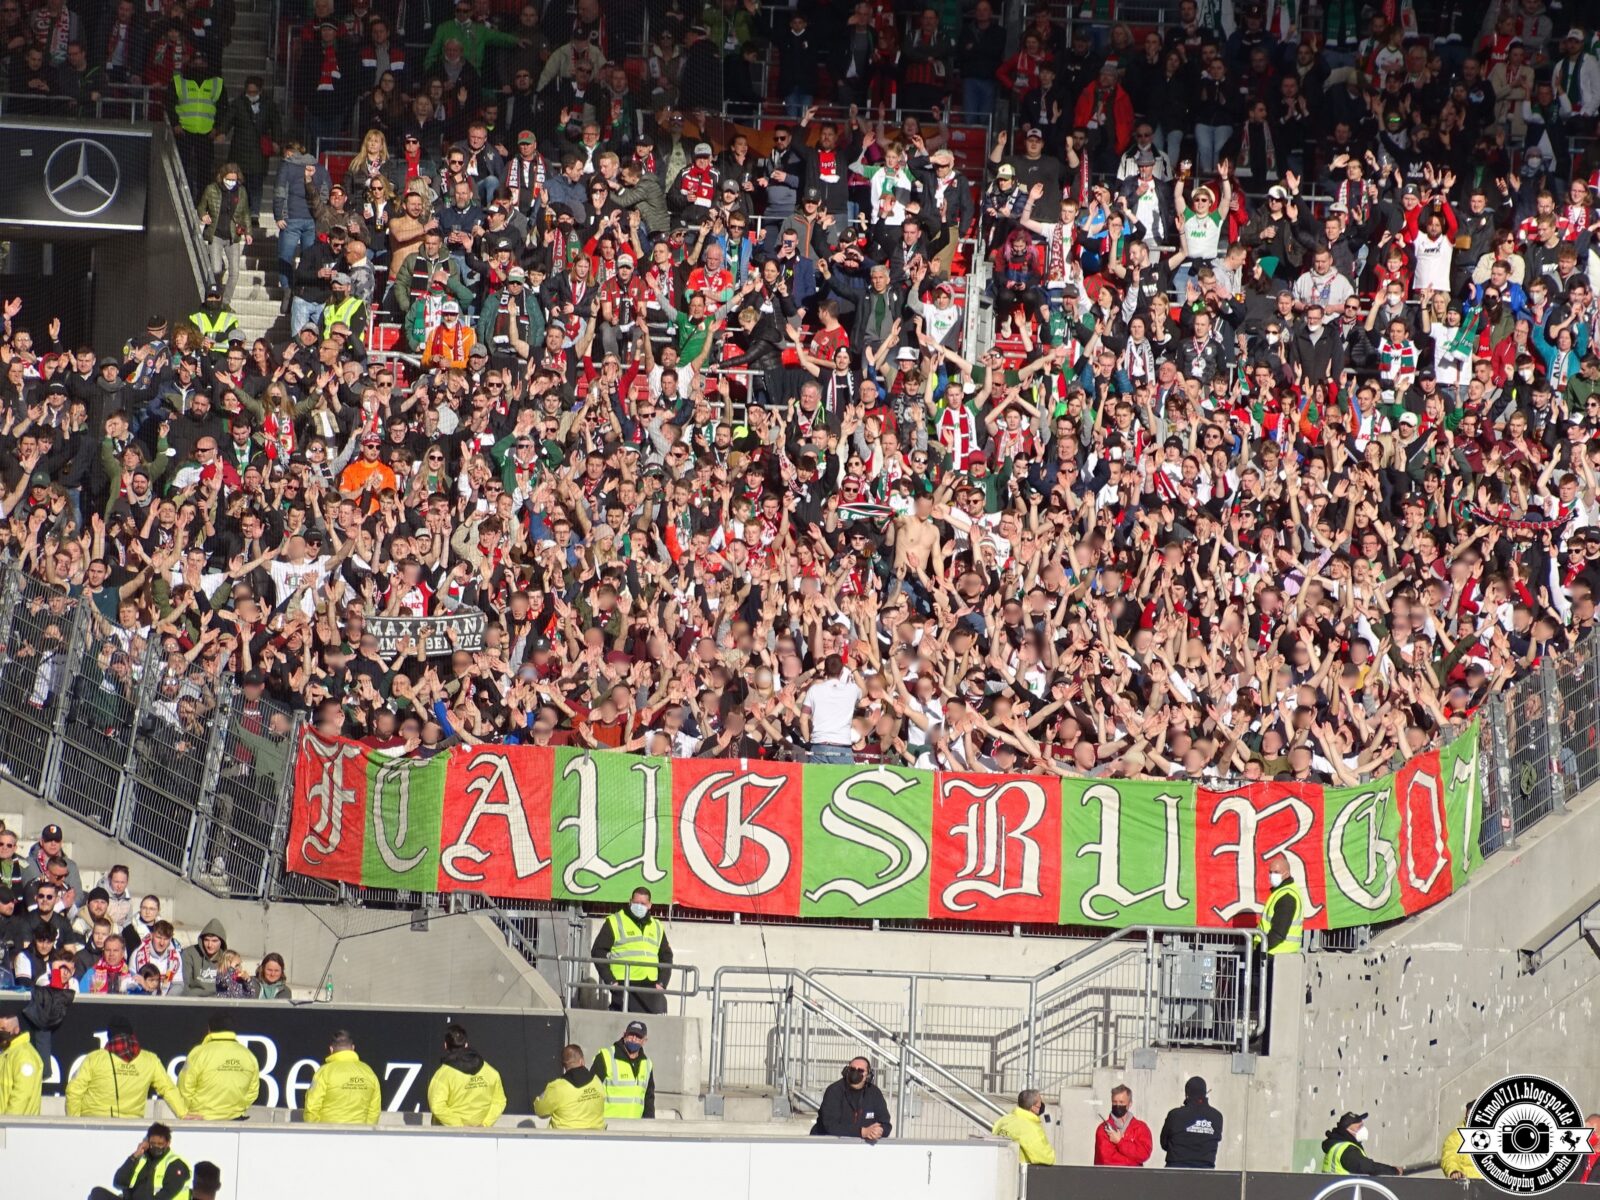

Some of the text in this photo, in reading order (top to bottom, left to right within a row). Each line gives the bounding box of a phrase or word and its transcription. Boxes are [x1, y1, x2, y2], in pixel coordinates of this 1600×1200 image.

[366, 619, 413, 636] MAX
[301, 730, 428, 873] FC
[440, 752, 1398, 923] AUGSBURG
